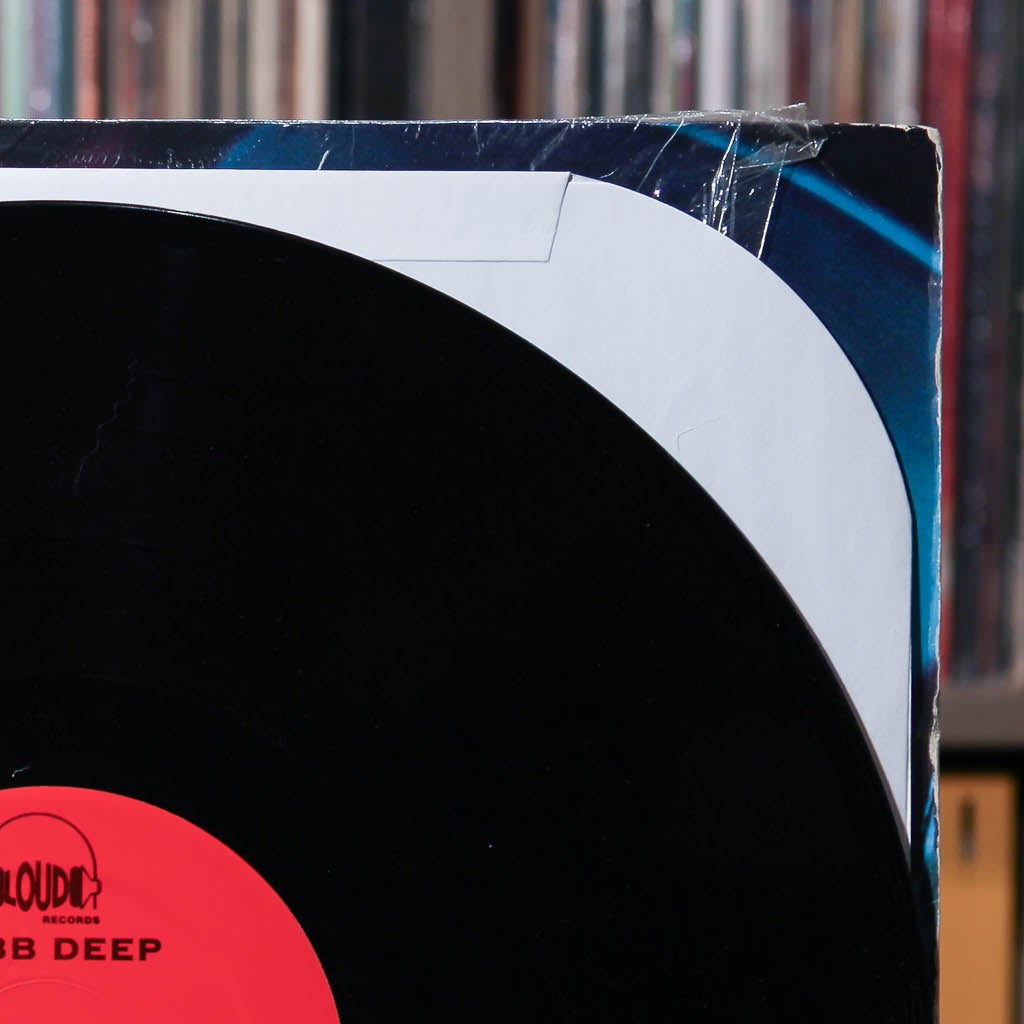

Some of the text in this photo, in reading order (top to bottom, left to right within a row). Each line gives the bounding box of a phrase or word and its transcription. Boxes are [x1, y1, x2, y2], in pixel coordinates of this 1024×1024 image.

[3, 861, 69, 911] LOUD
[42, 915, 100, 924] RECORDS
[53, 938, 162, 961] DEEP
